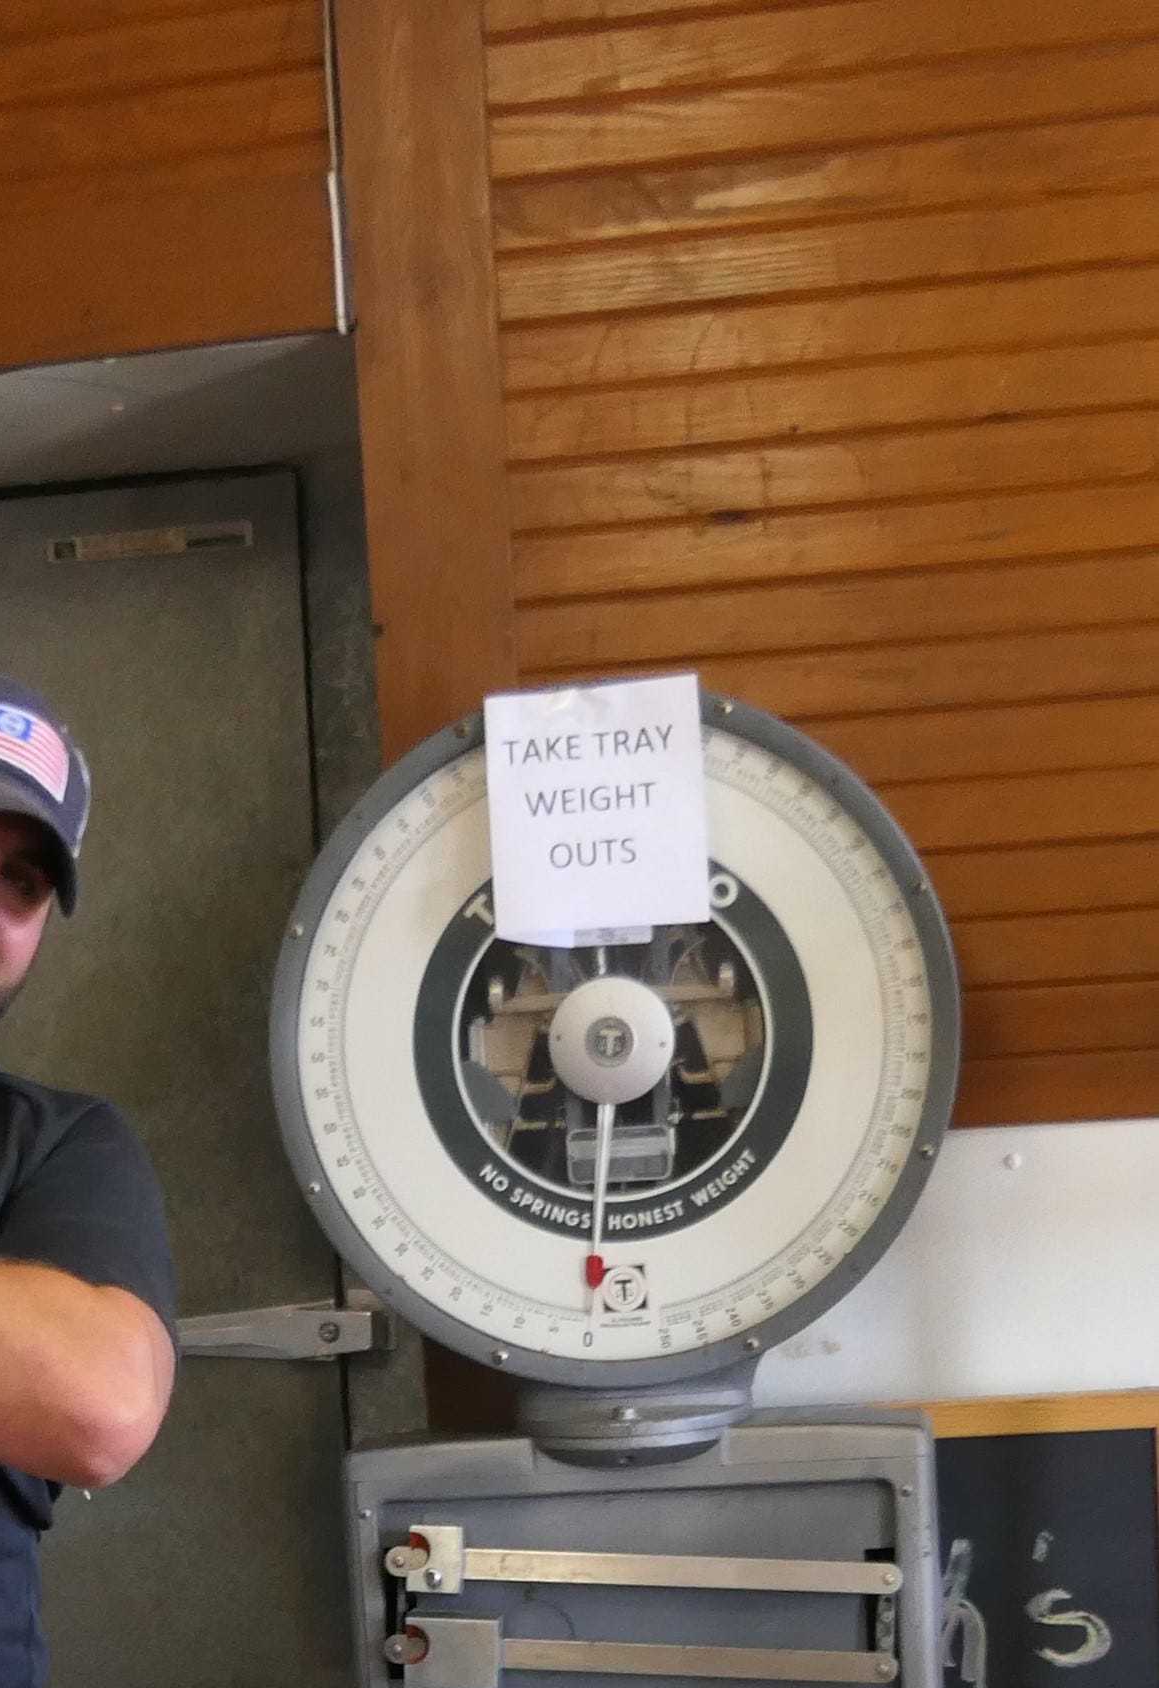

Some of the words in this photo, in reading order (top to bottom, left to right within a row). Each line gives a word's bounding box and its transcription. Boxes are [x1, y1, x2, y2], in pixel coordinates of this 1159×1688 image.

[502, 734, 583, 766] TAKE
[593, 724, 674, 758] TRAY
[525, 781, 657, 817] WEIGHT
[549, 837, 637, 869] OUTS
[479, 1163, 509, 1192] NO
[510, 1184, 592, 1230] SPRINGS
[607, 1200, 686, 1231] HONEST
[690, 1148, 757, 1208] WEIGHT
[583, 1331, 593, 1348] 0
